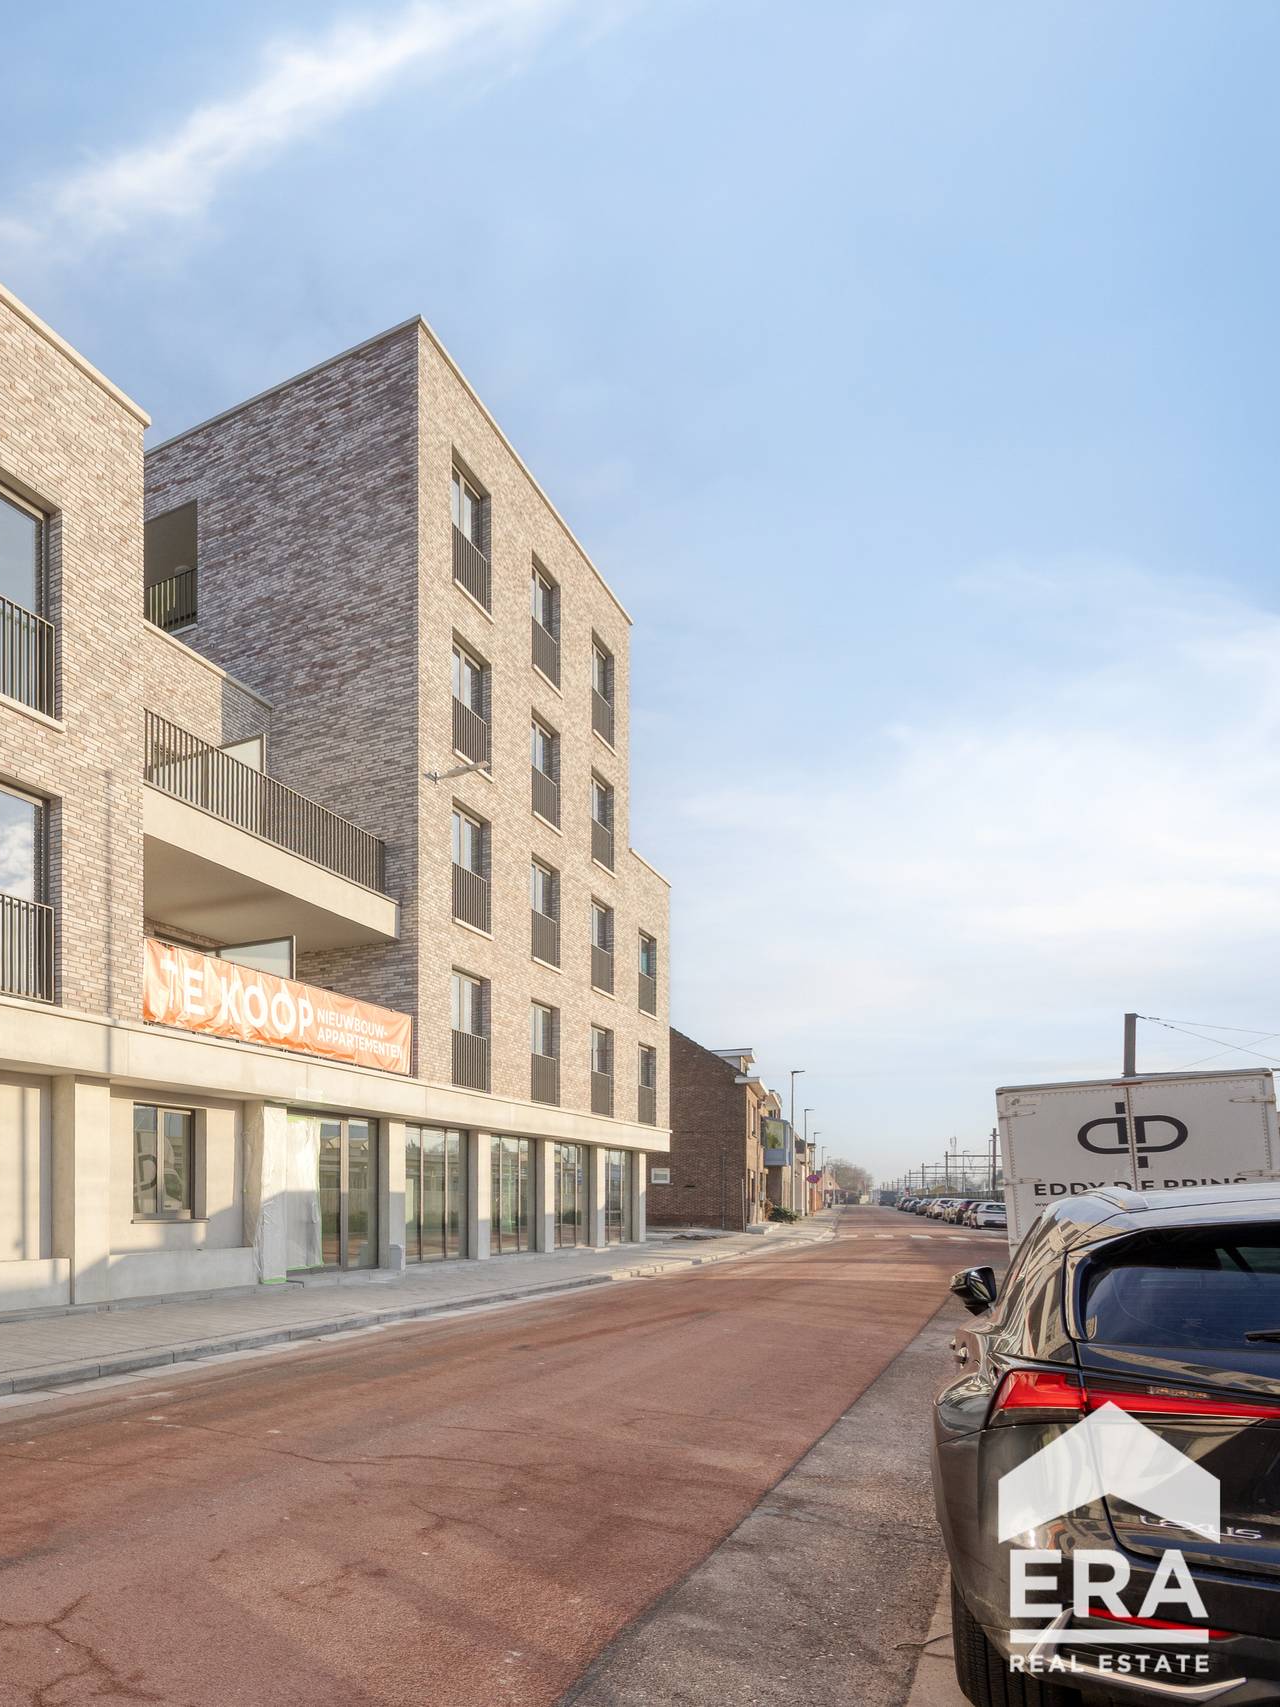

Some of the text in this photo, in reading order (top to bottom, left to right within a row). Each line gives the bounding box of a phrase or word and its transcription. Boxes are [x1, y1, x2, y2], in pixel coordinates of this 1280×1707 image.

[160, 957, 314, 1038] TE KOOP
[317, 1007, 404, 1059] NIEUWBOUW- APPARTEMENTEN
[1034, 1181, 1106, 1197] EDDY
